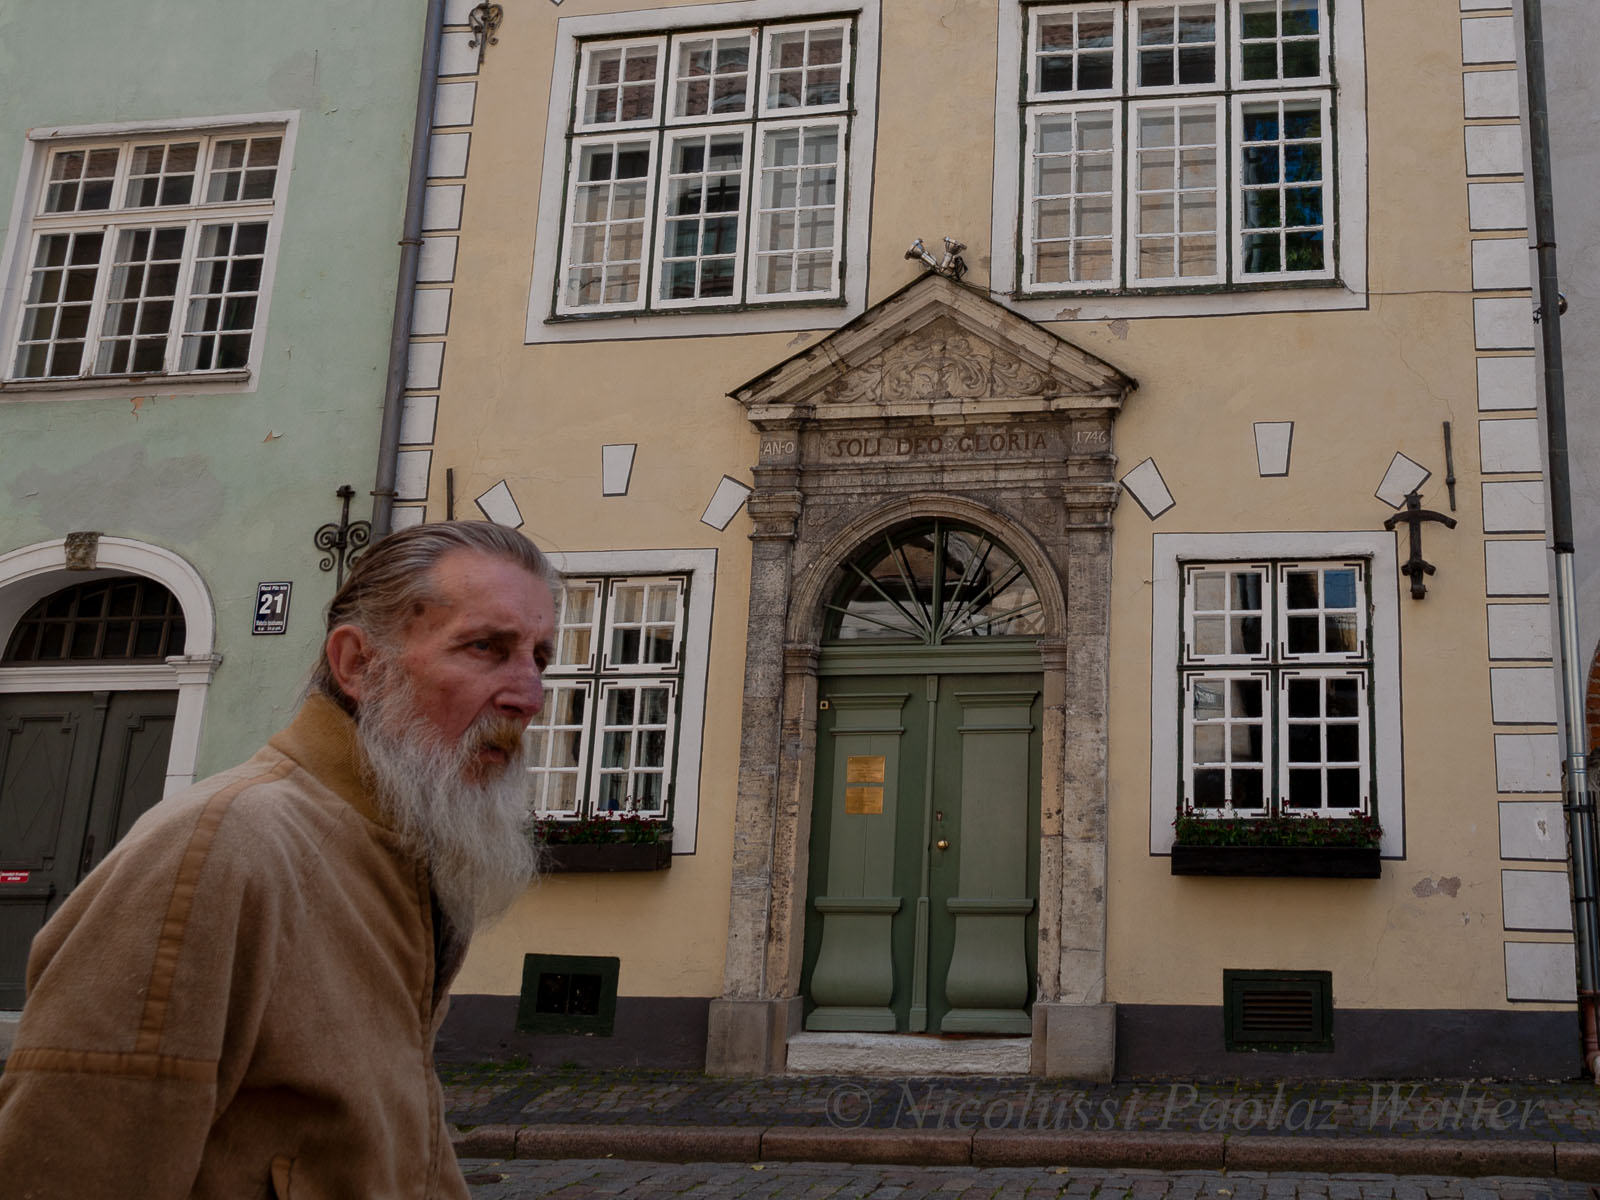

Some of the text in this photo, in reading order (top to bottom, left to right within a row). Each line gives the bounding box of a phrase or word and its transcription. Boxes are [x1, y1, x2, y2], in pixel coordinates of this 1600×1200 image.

[831, 433, 1048, 458] SOLI DEO GLORIA
[1075, 430, 1107, 445] 1746
[259, 593, 284, 614] 21
